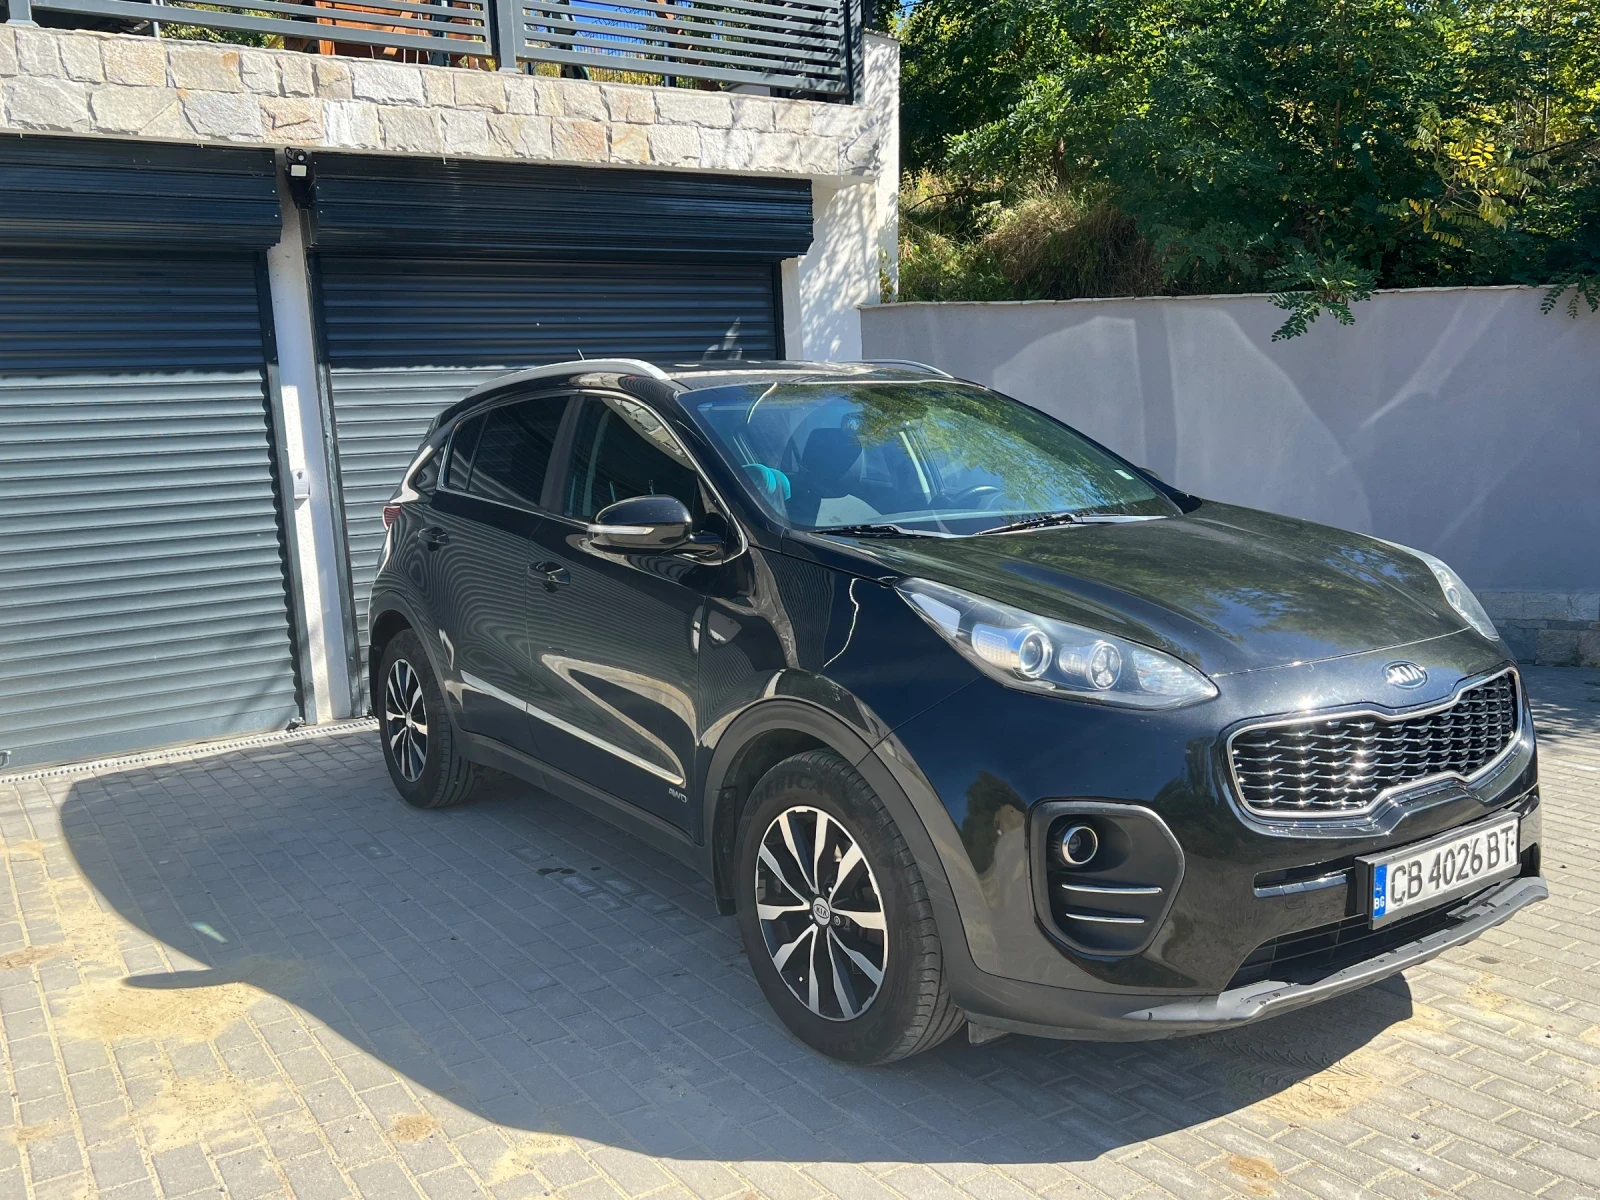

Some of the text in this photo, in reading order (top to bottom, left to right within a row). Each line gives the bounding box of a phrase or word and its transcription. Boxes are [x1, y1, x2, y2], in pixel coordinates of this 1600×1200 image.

[1388, 664, 1424, 684] KIA
[668, 787, 687, 803] AWD
[1391, 825, 1514, 905] CB 4026 BT
[1374, 896, 1385, 910] BG
[815, 906, 827, 917] KIA
